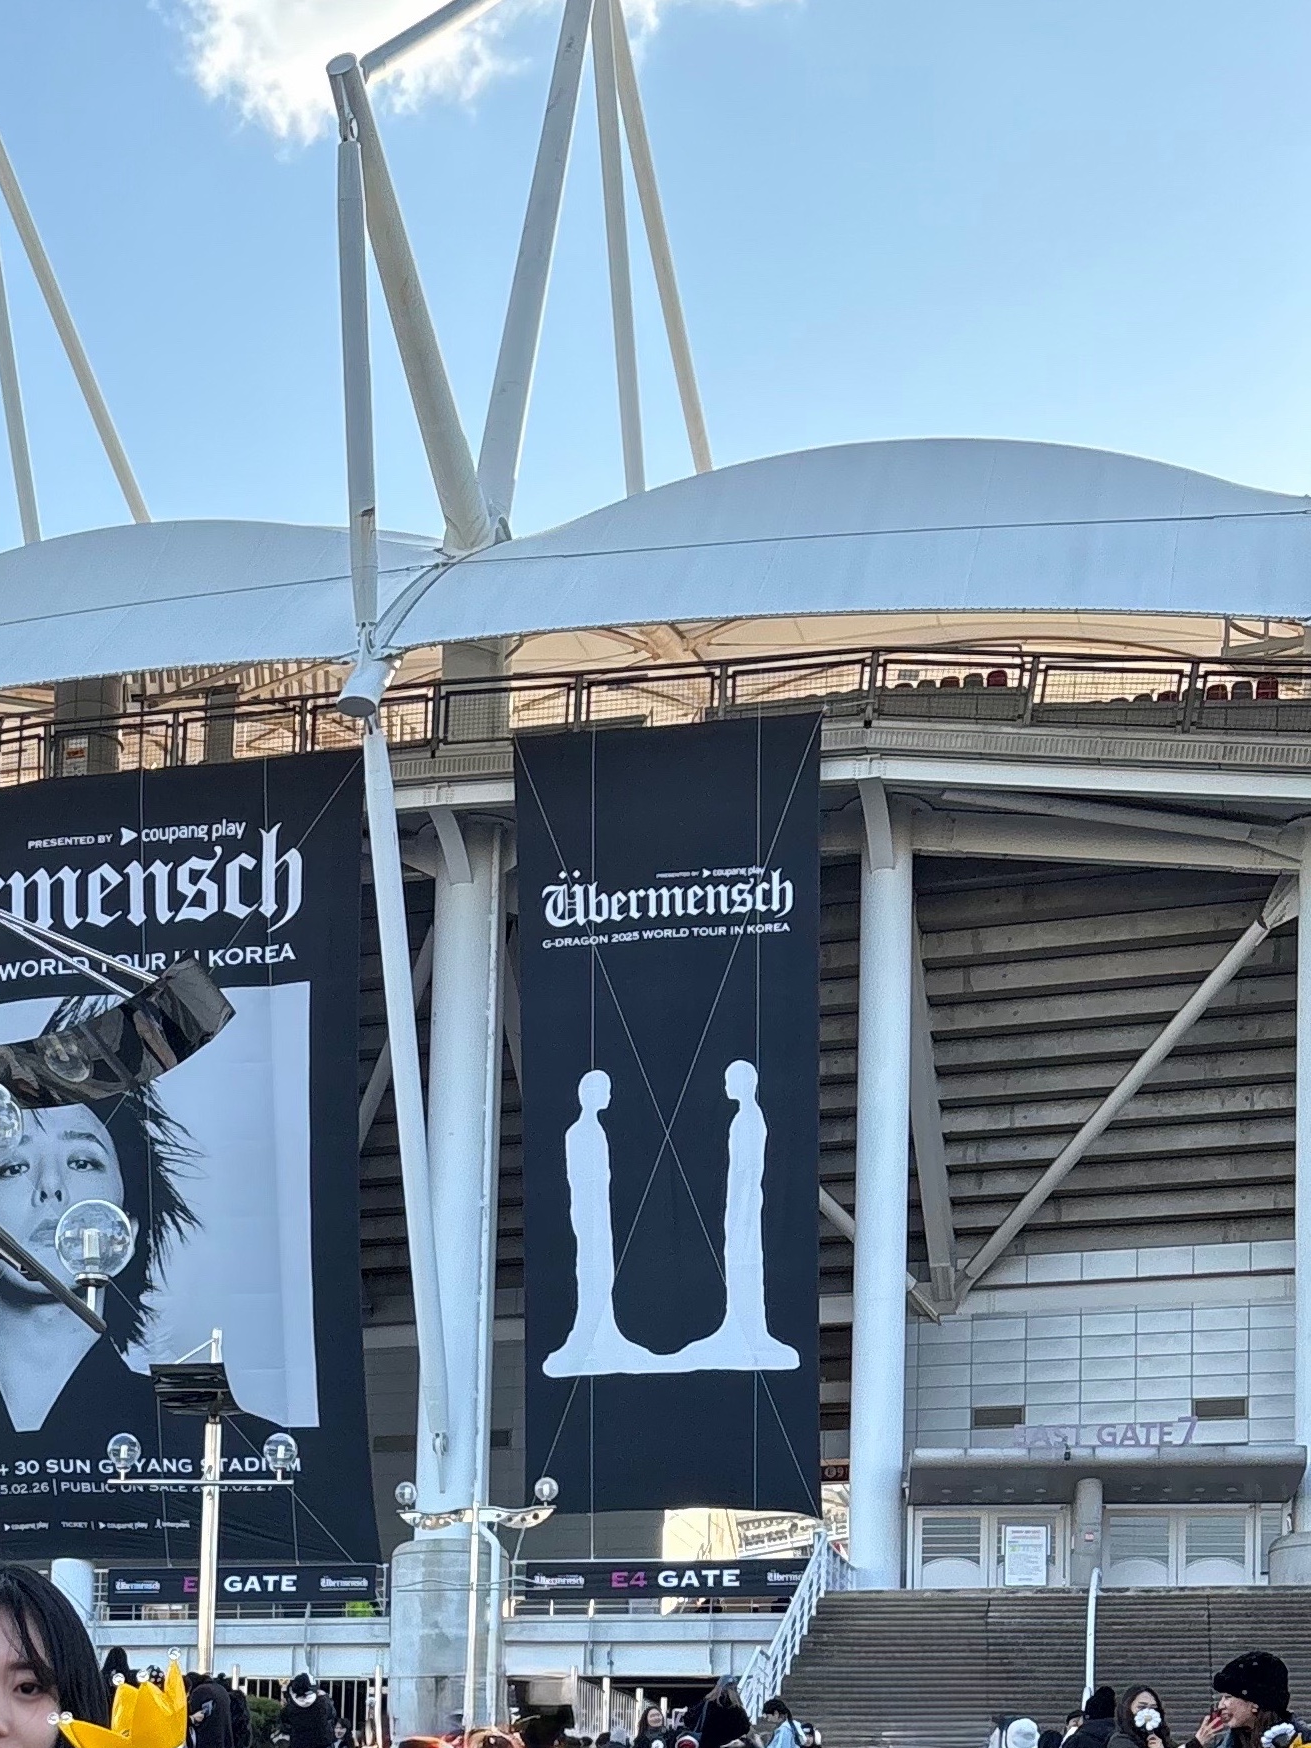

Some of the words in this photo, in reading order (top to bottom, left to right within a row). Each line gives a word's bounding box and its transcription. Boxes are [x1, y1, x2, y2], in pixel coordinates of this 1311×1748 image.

[27, 835, 95, 850] PRESENTED
[97, 833, 113, 845] BY
[141, 825, 209, 845] coupang
[211, 818, 246, 841] play
[541, 867, 795, 928] Übermensch
[542, 935, 609, 950] G-DRAGON
[611, 931, 640, 944] 2025
[641, 928, 690, 940] WORLD
[692, 926, 727, 937] TOUR
[730, 924, 743, 936] IN
[747, 922, 791, 934] KOREA
[208, 942, 297, 968] KOREA
[14, 1460, 40, 1476] 30
[46, 1458, 90, 1475] SUN
[98, 1457, 194, 1474] GYANG
[200, 1456, 302, 1473] TADIM
[182, 1576, 198, 1593] E
[223, 1574, 298, 1592] GATE
[610, 1571, 647, 1588] E4
[657, 1569, 741, 1588] GATE
